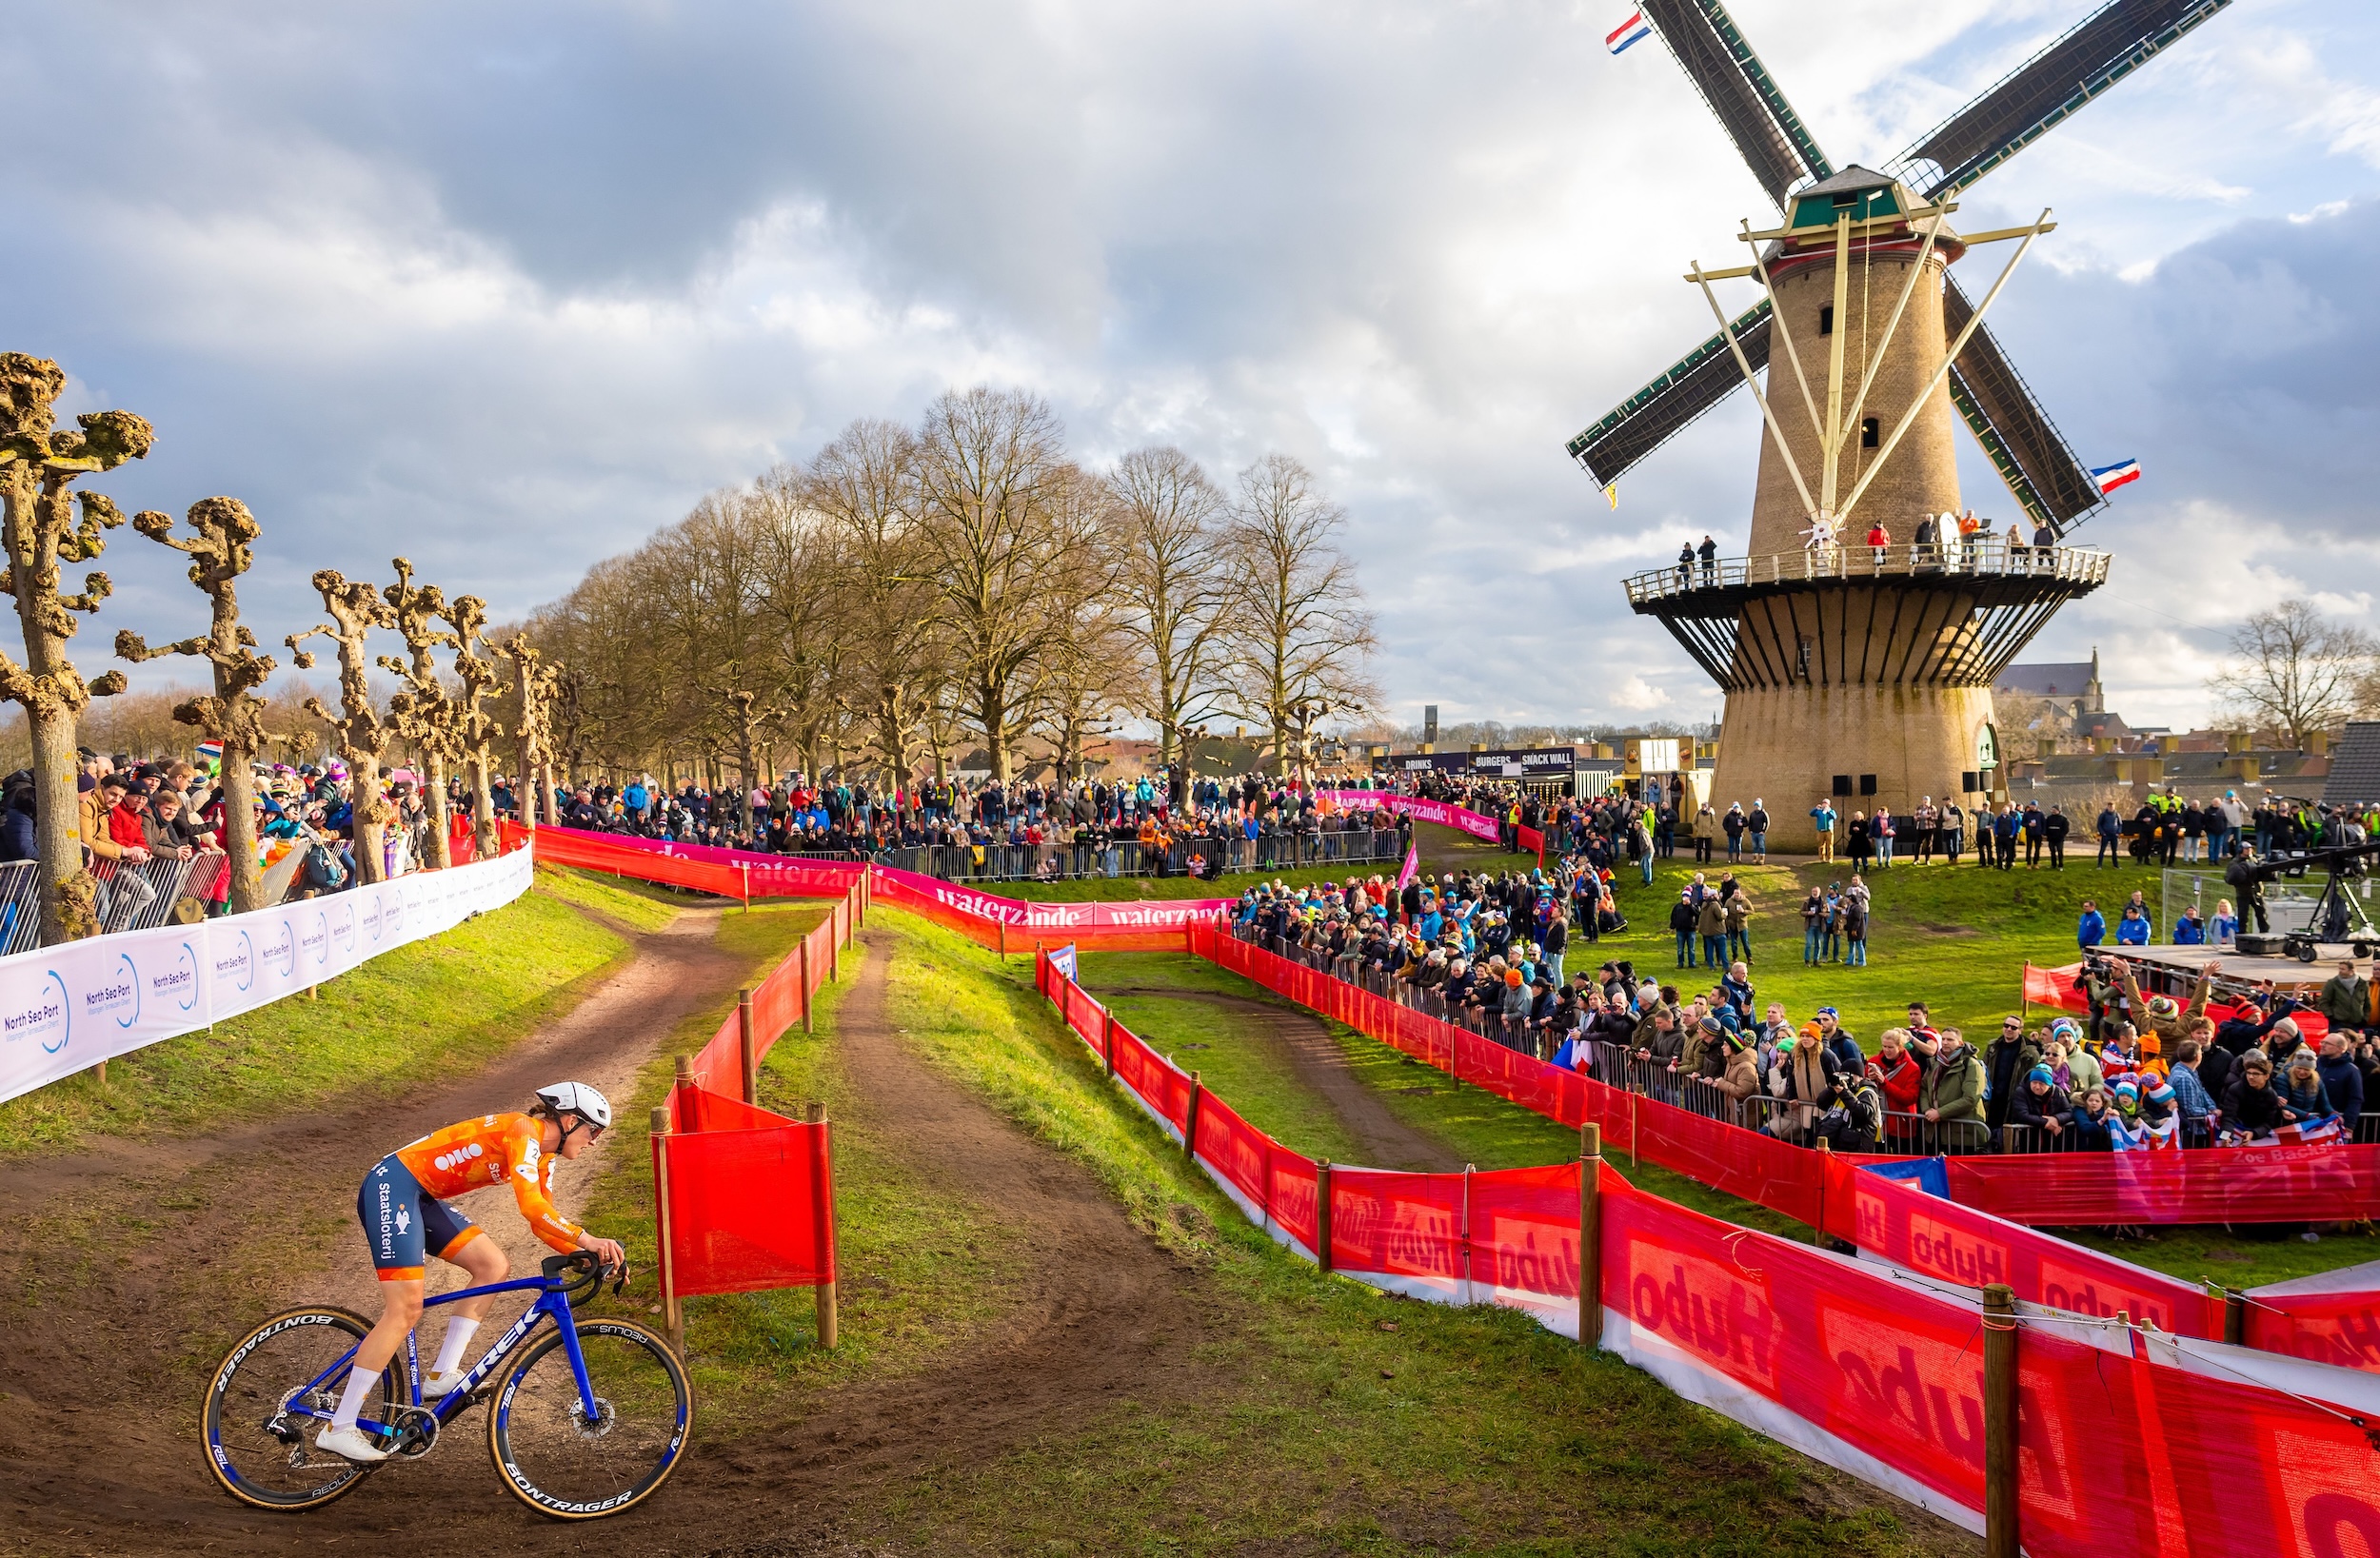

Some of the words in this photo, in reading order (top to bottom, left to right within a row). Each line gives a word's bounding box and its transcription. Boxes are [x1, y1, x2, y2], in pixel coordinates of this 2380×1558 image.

[1405, 759, 1433, 770] DRINKS
[1476, 756, 1512, 767] BURGERS
[1522, 754, 1547, 765] SNACK
[1549, 753, 1572, 764] WALL
[731, 859, 899, 896] waterzade
[936, 888, 1081, 929] waterzande
[216, 960, 228, 971] North
[229, 957, 238, 967] Sea
[238, 956, 248, 965] Port
[153, 976, 169, 988] North
[169, 973, 179, 983] Sea
[180, 971, 190, 982] Port
[86, 992, 104, 1006] North
[105, 988, 116, 1000] Sea
[118, 984, 130, 997] Port
[4, 1013, 27, 1032] North
[29, 1010, 42, 1024] Sea
[45, 1004, 59, 1020] Port
[532, 1148, 539, 1159] 2
[2233, 1151, 2265, 1163] Zoe
[379, 1183, 396, 1260] Staatsloterij
[600, 1325, 649, 1344] AEOLUS
[217, 1315, 334, 1392] BONTRAGER
[452, 1304, 541, 1394] TREK
[501, 1381, 516, 1410] RSL
[670, 1423, 684, 1452] RL
[212, 1444, 230, 1470] RSL
[506, 1463, 633, 1512] BONTRAGER
